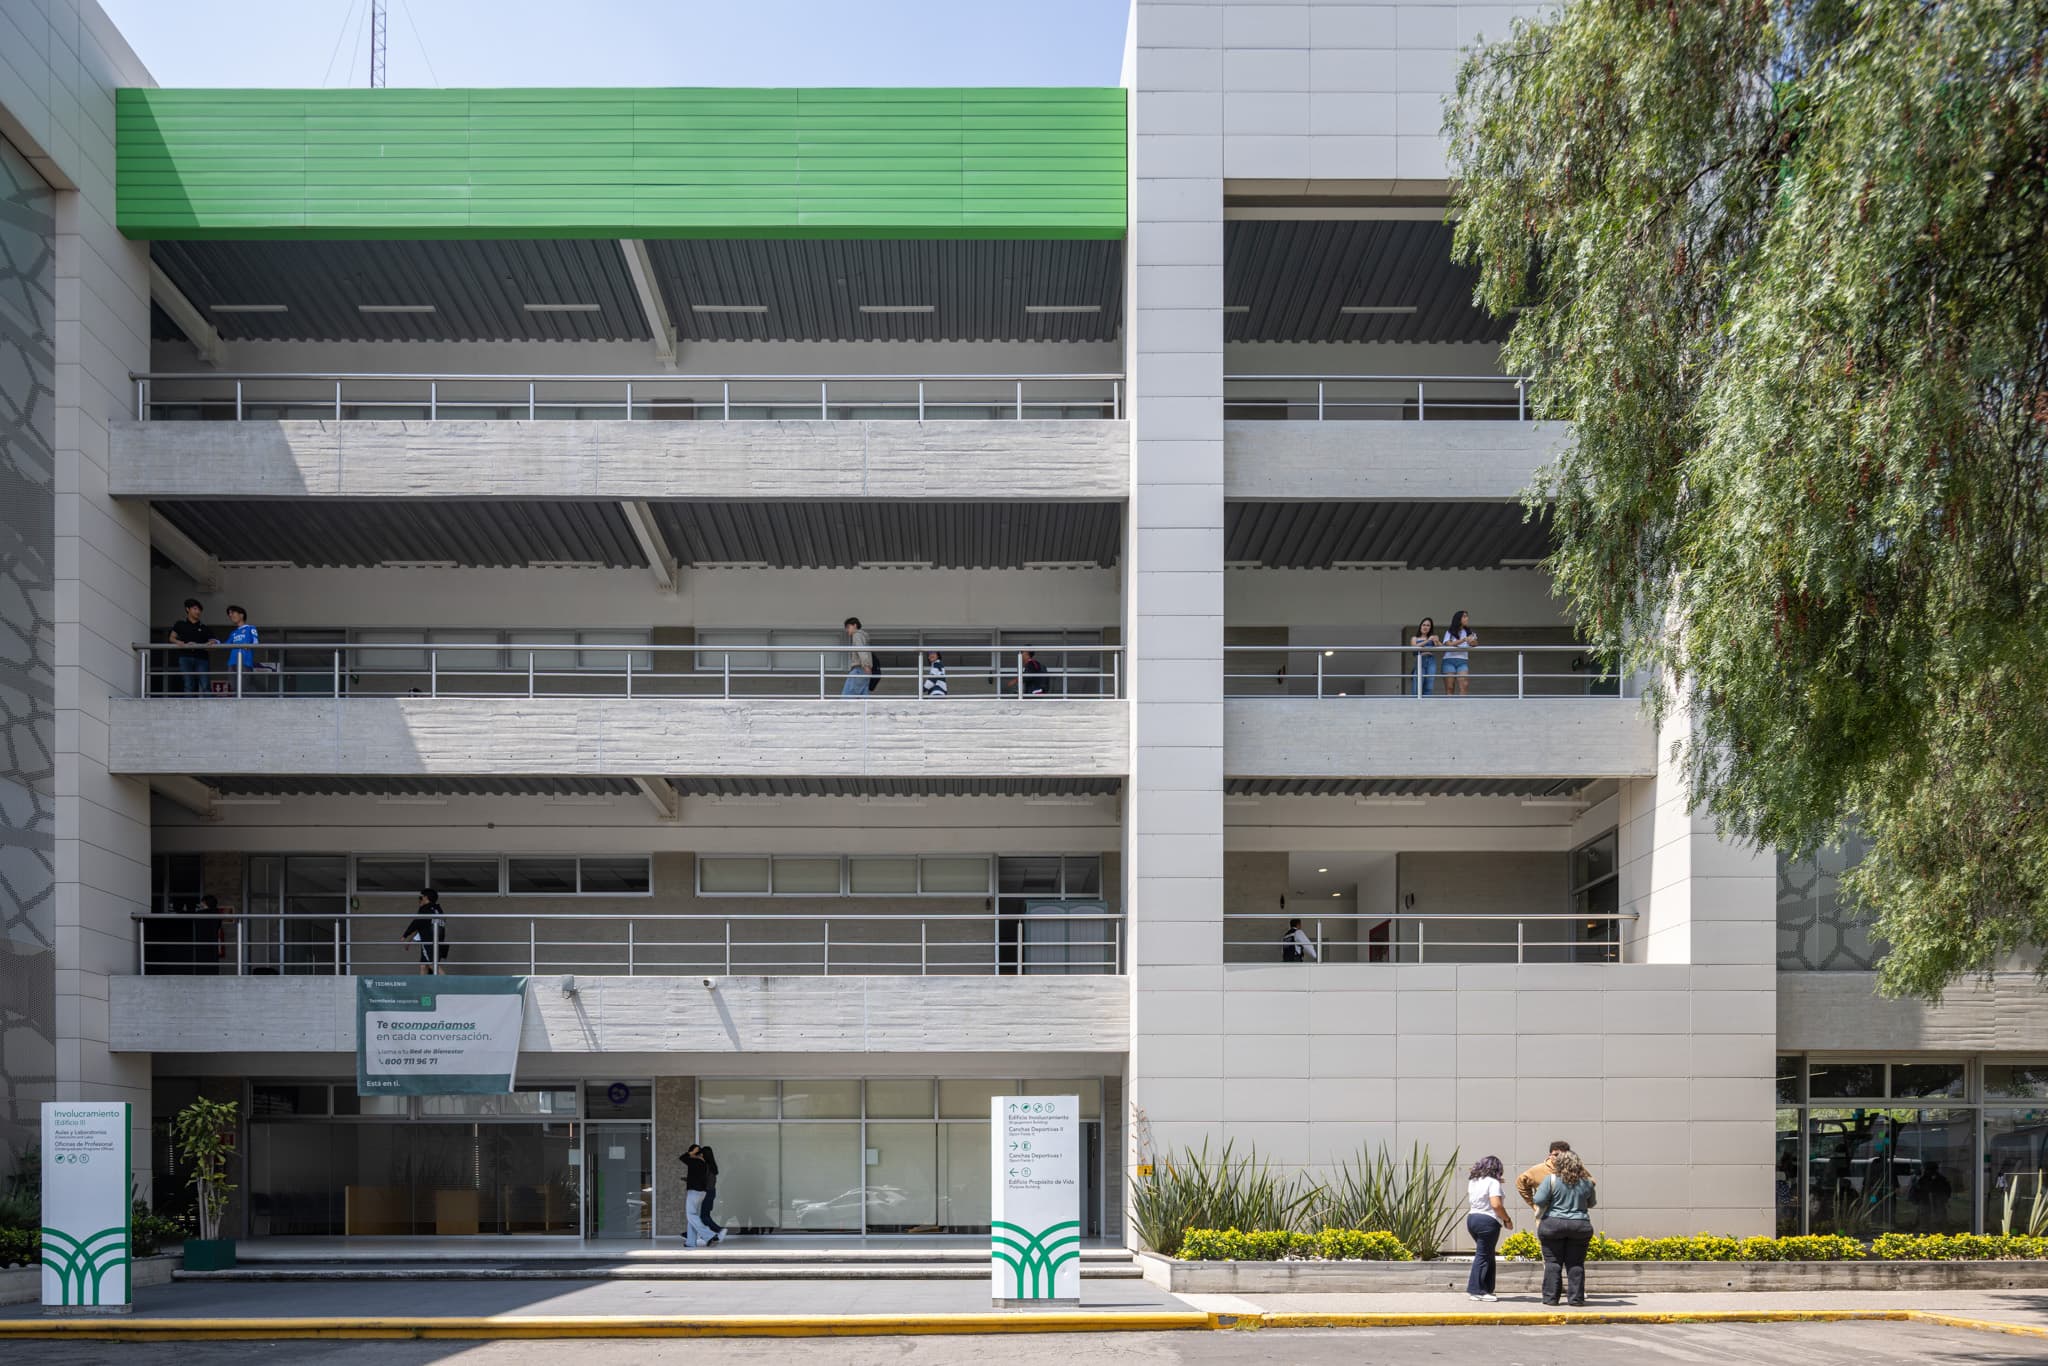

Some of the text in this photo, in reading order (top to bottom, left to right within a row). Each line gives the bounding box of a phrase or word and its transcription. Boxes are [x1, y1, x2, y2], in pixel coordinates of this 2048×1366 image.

[377, 1020, 475, 1031] Te acompañamos
[376, 1032, 492, 1042] en cada conversación.
[54, 1109, 120, 1118] Involucramiento
